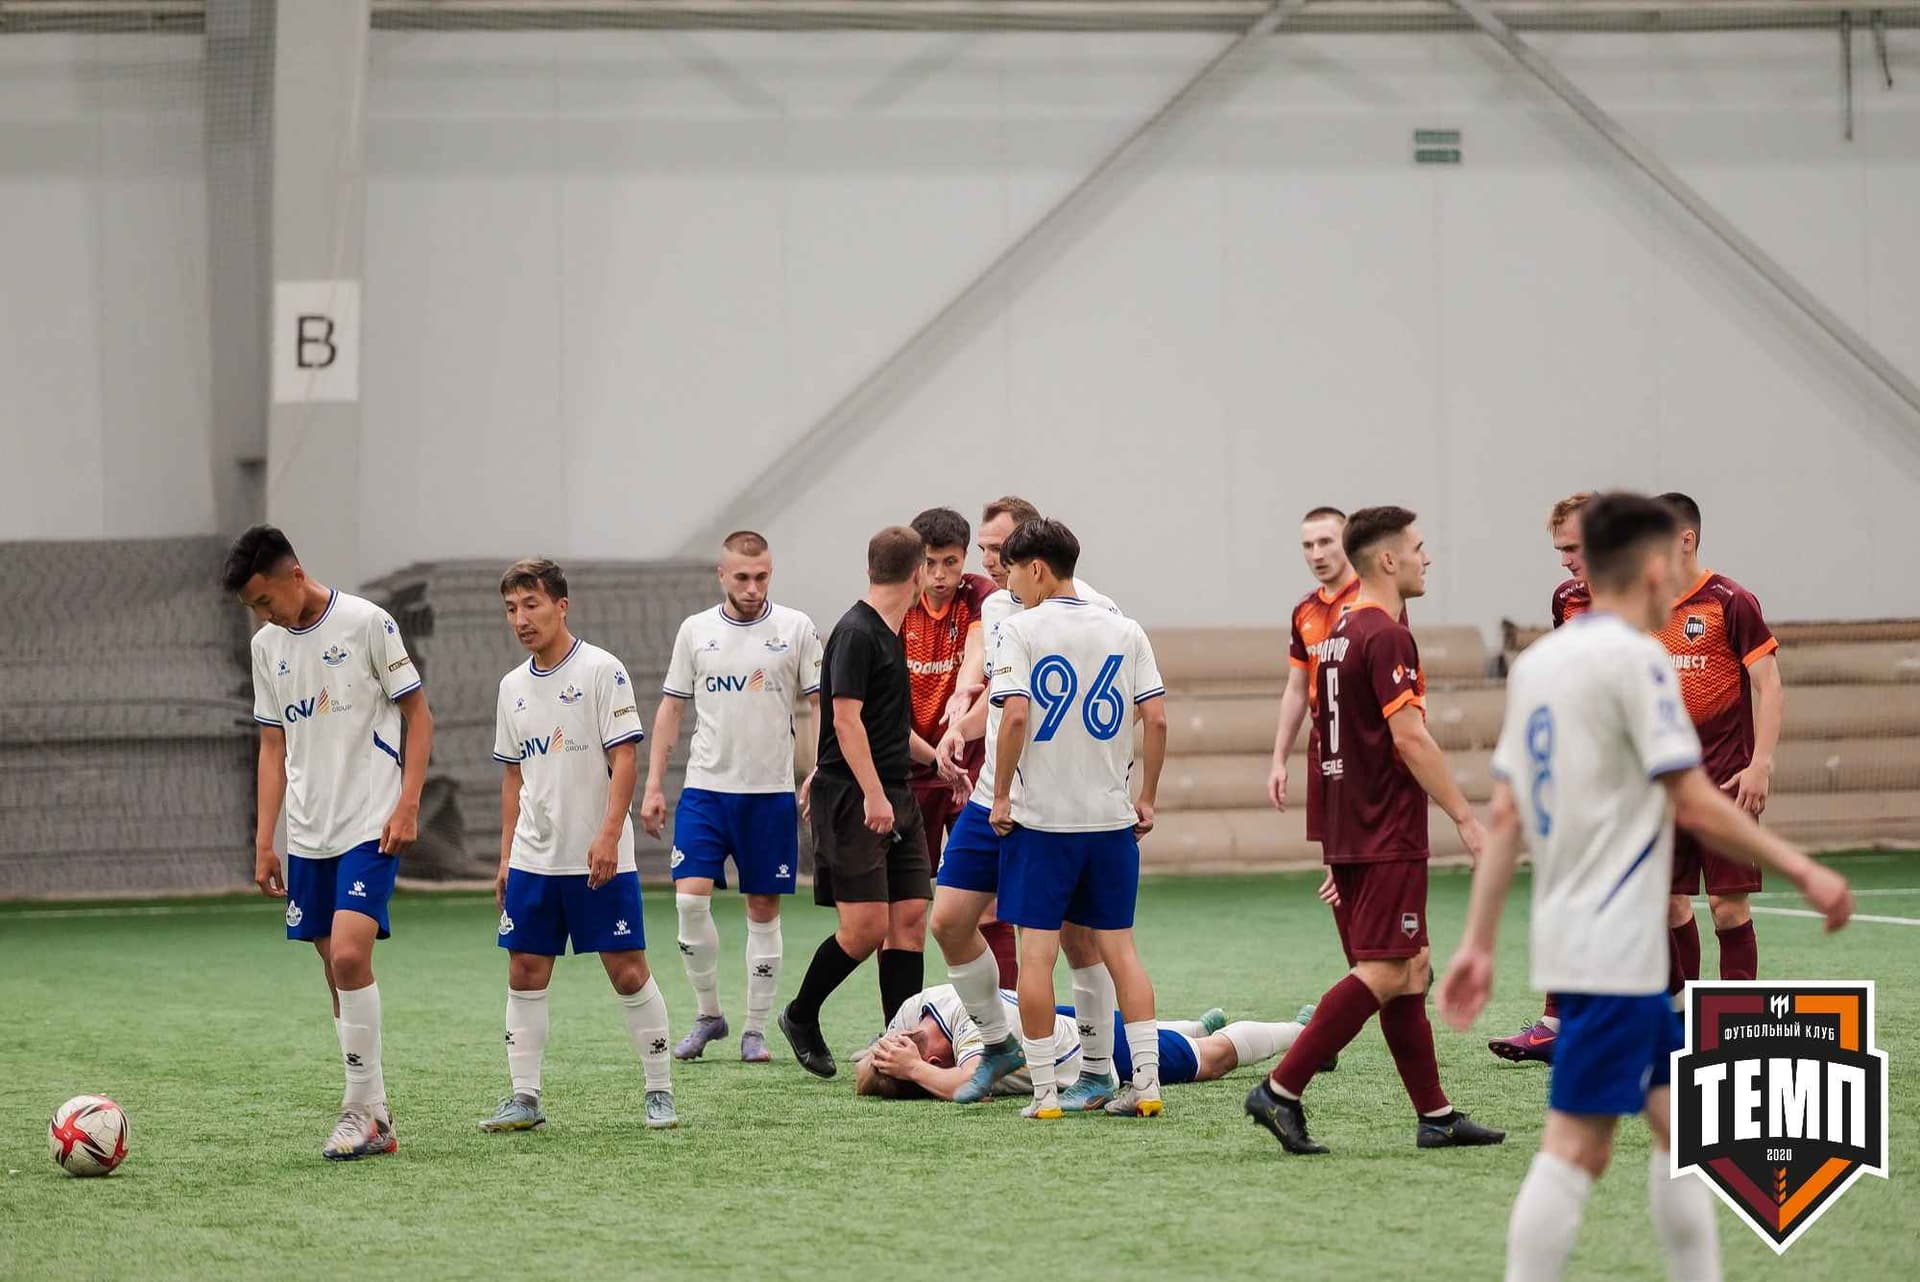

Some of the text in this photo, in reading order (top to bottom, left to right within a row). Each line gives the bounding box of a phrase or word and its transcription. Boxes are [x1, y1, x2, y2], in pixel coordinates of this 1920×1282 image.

[297, 315, 336, 369] B
[705, 675, 747, 692] GNV
[1030, 655, 1125, 742] 96
[285, 697, 315, 723] GNV
[1326, 667, 1340, 753] 5
[565, 744, 589, 752] GROUP
